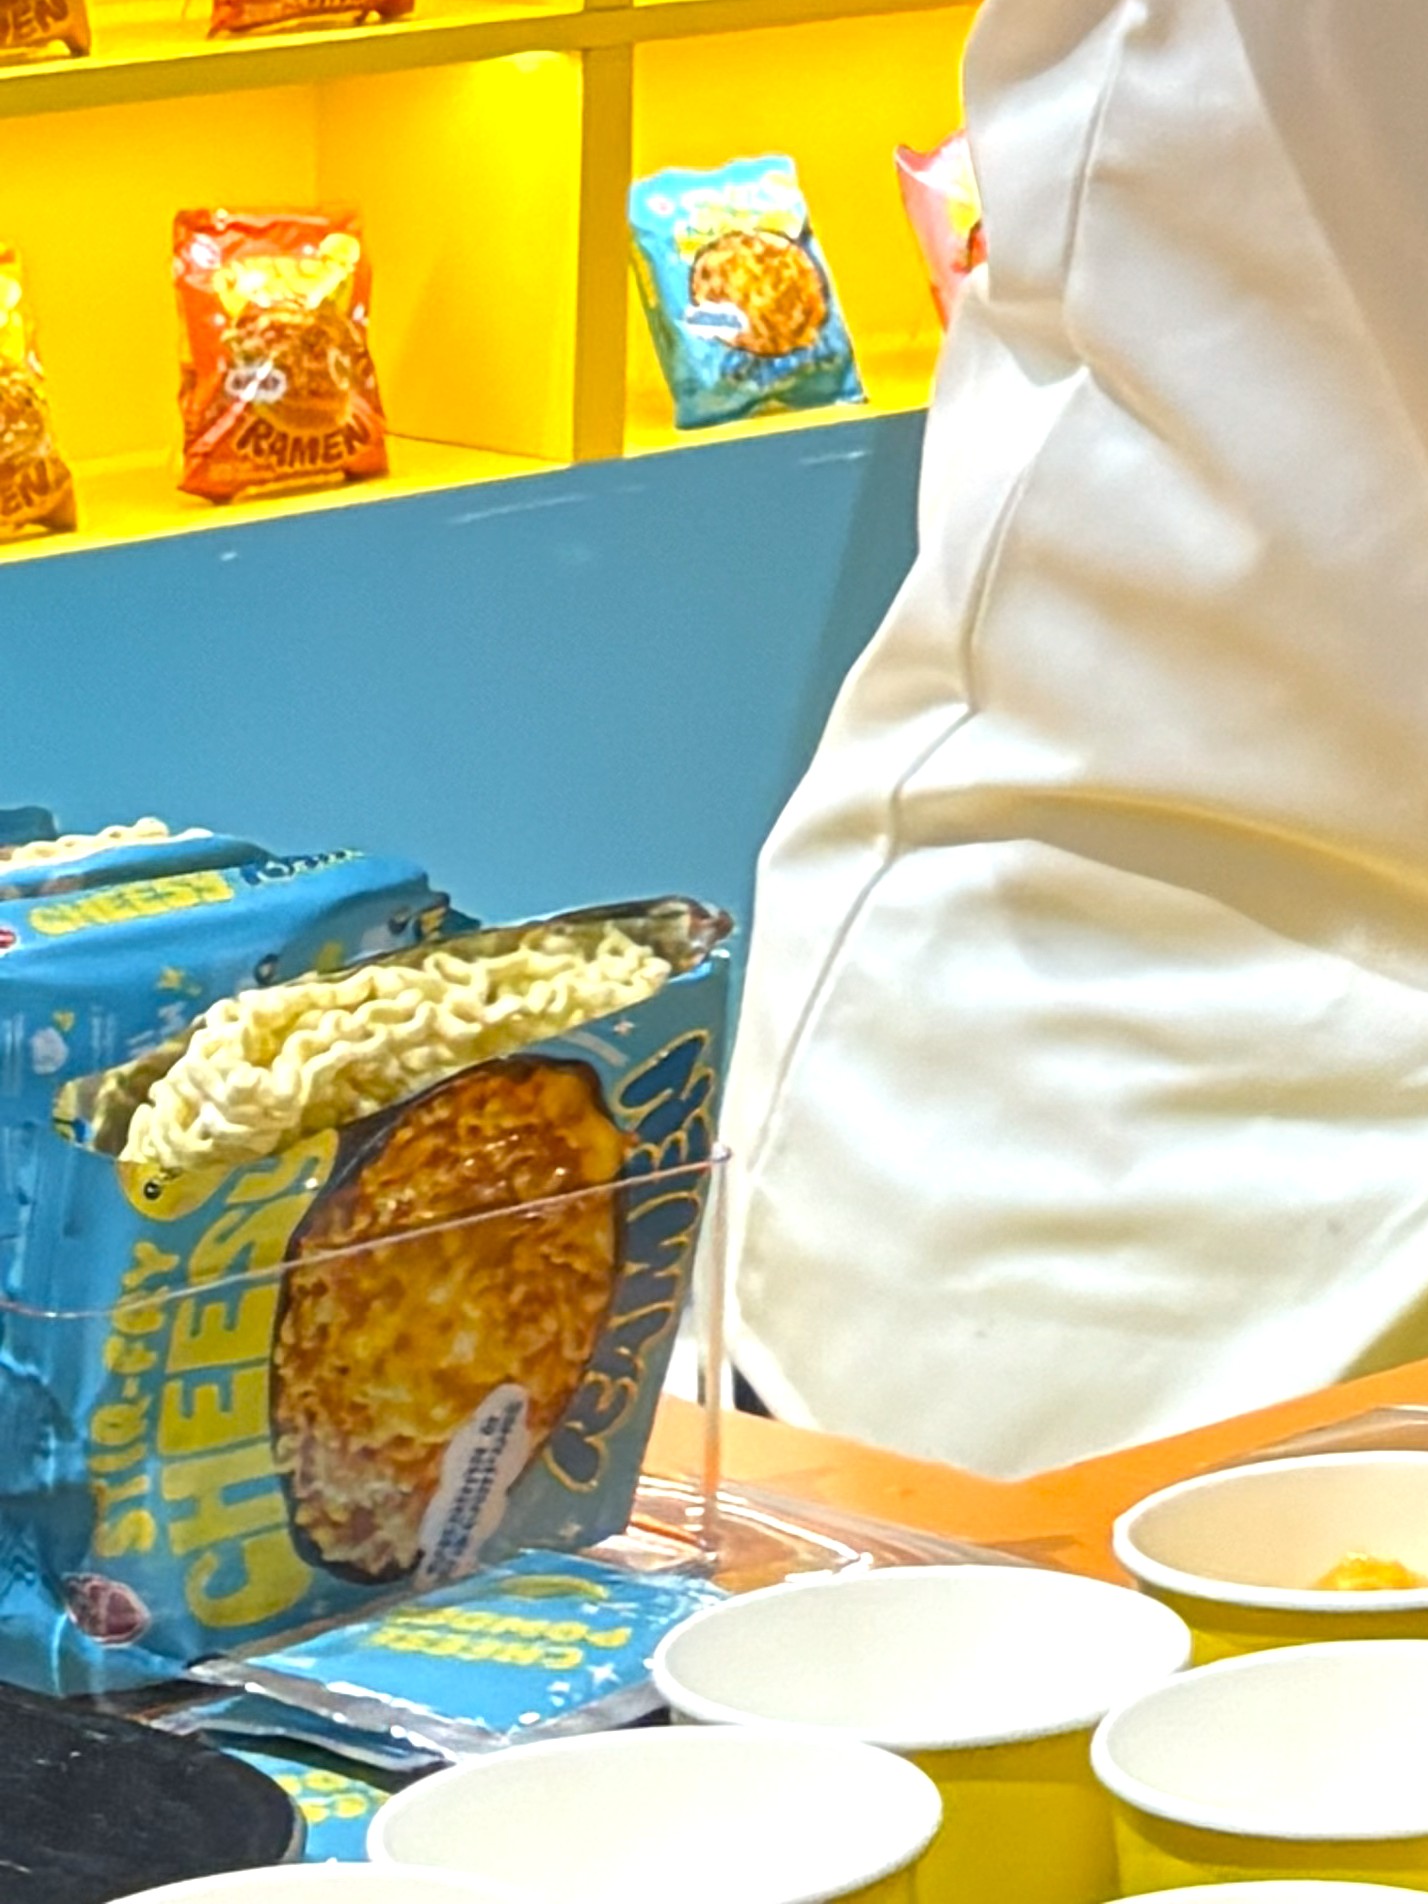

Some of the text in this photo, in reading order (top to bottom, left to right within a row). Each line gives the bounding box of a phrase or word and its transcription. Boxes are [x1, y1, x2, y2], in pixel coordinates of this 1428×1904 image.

[236, 415, 371, 469] RAMEN
[91, 1241, 179, 1558] STIR-FRY
[157, 1127, 339, 1628] CHEESY
[545, 1029, 714, 1494] RAMEN
